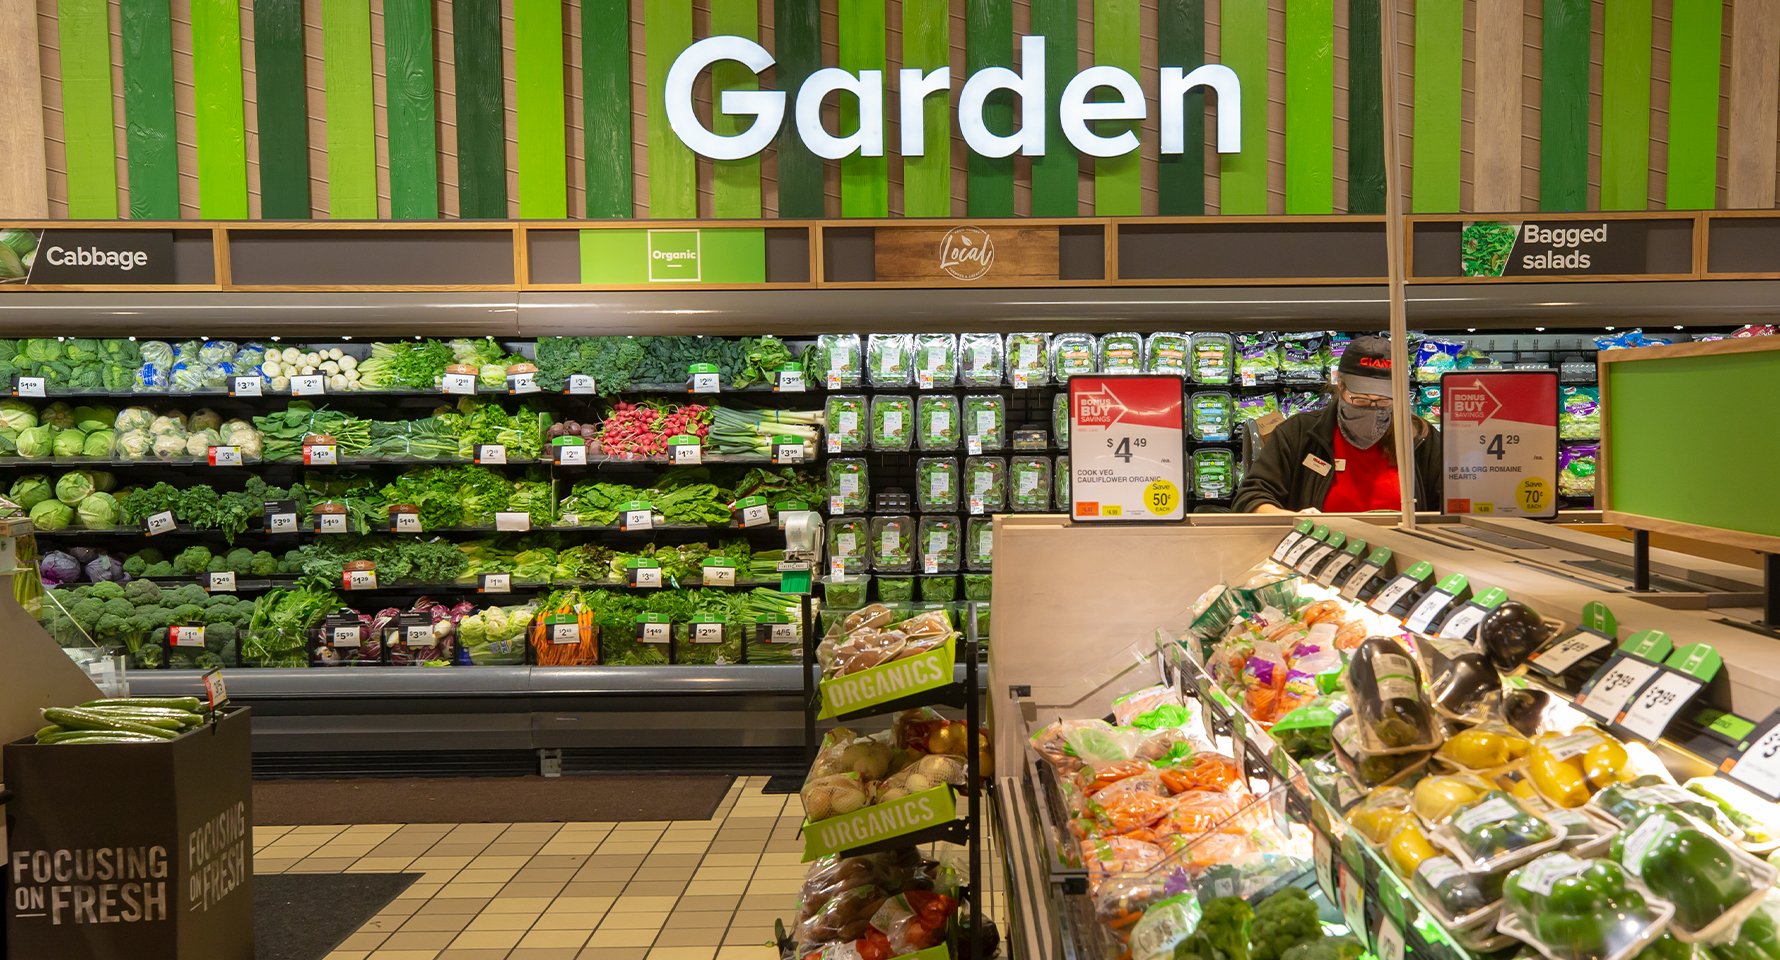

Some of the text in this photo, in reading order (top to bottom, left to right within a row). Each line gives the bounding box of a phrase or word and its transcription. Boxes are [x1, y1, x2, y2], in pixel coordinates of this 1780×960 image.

[664, 35, 1241, 160] Garden
[1523, 224, 1607, 248] Bagged
[652, 249, 697, 261] Organic
[940, 234, 992, 269] Local
[46, 246, 148, 271] Cabbage
[1522, 250, 1591, 269] salads
[20, 382, 37, 390] $149
[1081, 406, 1110, 416] BUY
[1454, 401, 1484, 412] BUY
[313, 451, 329, 459] $129
[150, 518, 167, 527] $299
[273, 518, 291, 526] $399
[323, 518, 339, 526] $149
[399, 518, 415, 526] $149
[212, 577, 230, 585] $249
[336, 632, 354, 640] $599
[646, 628, 662, 636] $149
[698, 628, 717, 636] $299
[828, 656, 943, 708] ORGANICS
[1645, 686, 1676, 709] $399
[189, 800, 245, 872] FOCUSING
[12, 846, 168, 884] FOCUSING
[189, 840, 245, 912] ON FRESH
[15, 882, 167, 925] ON FRESH
